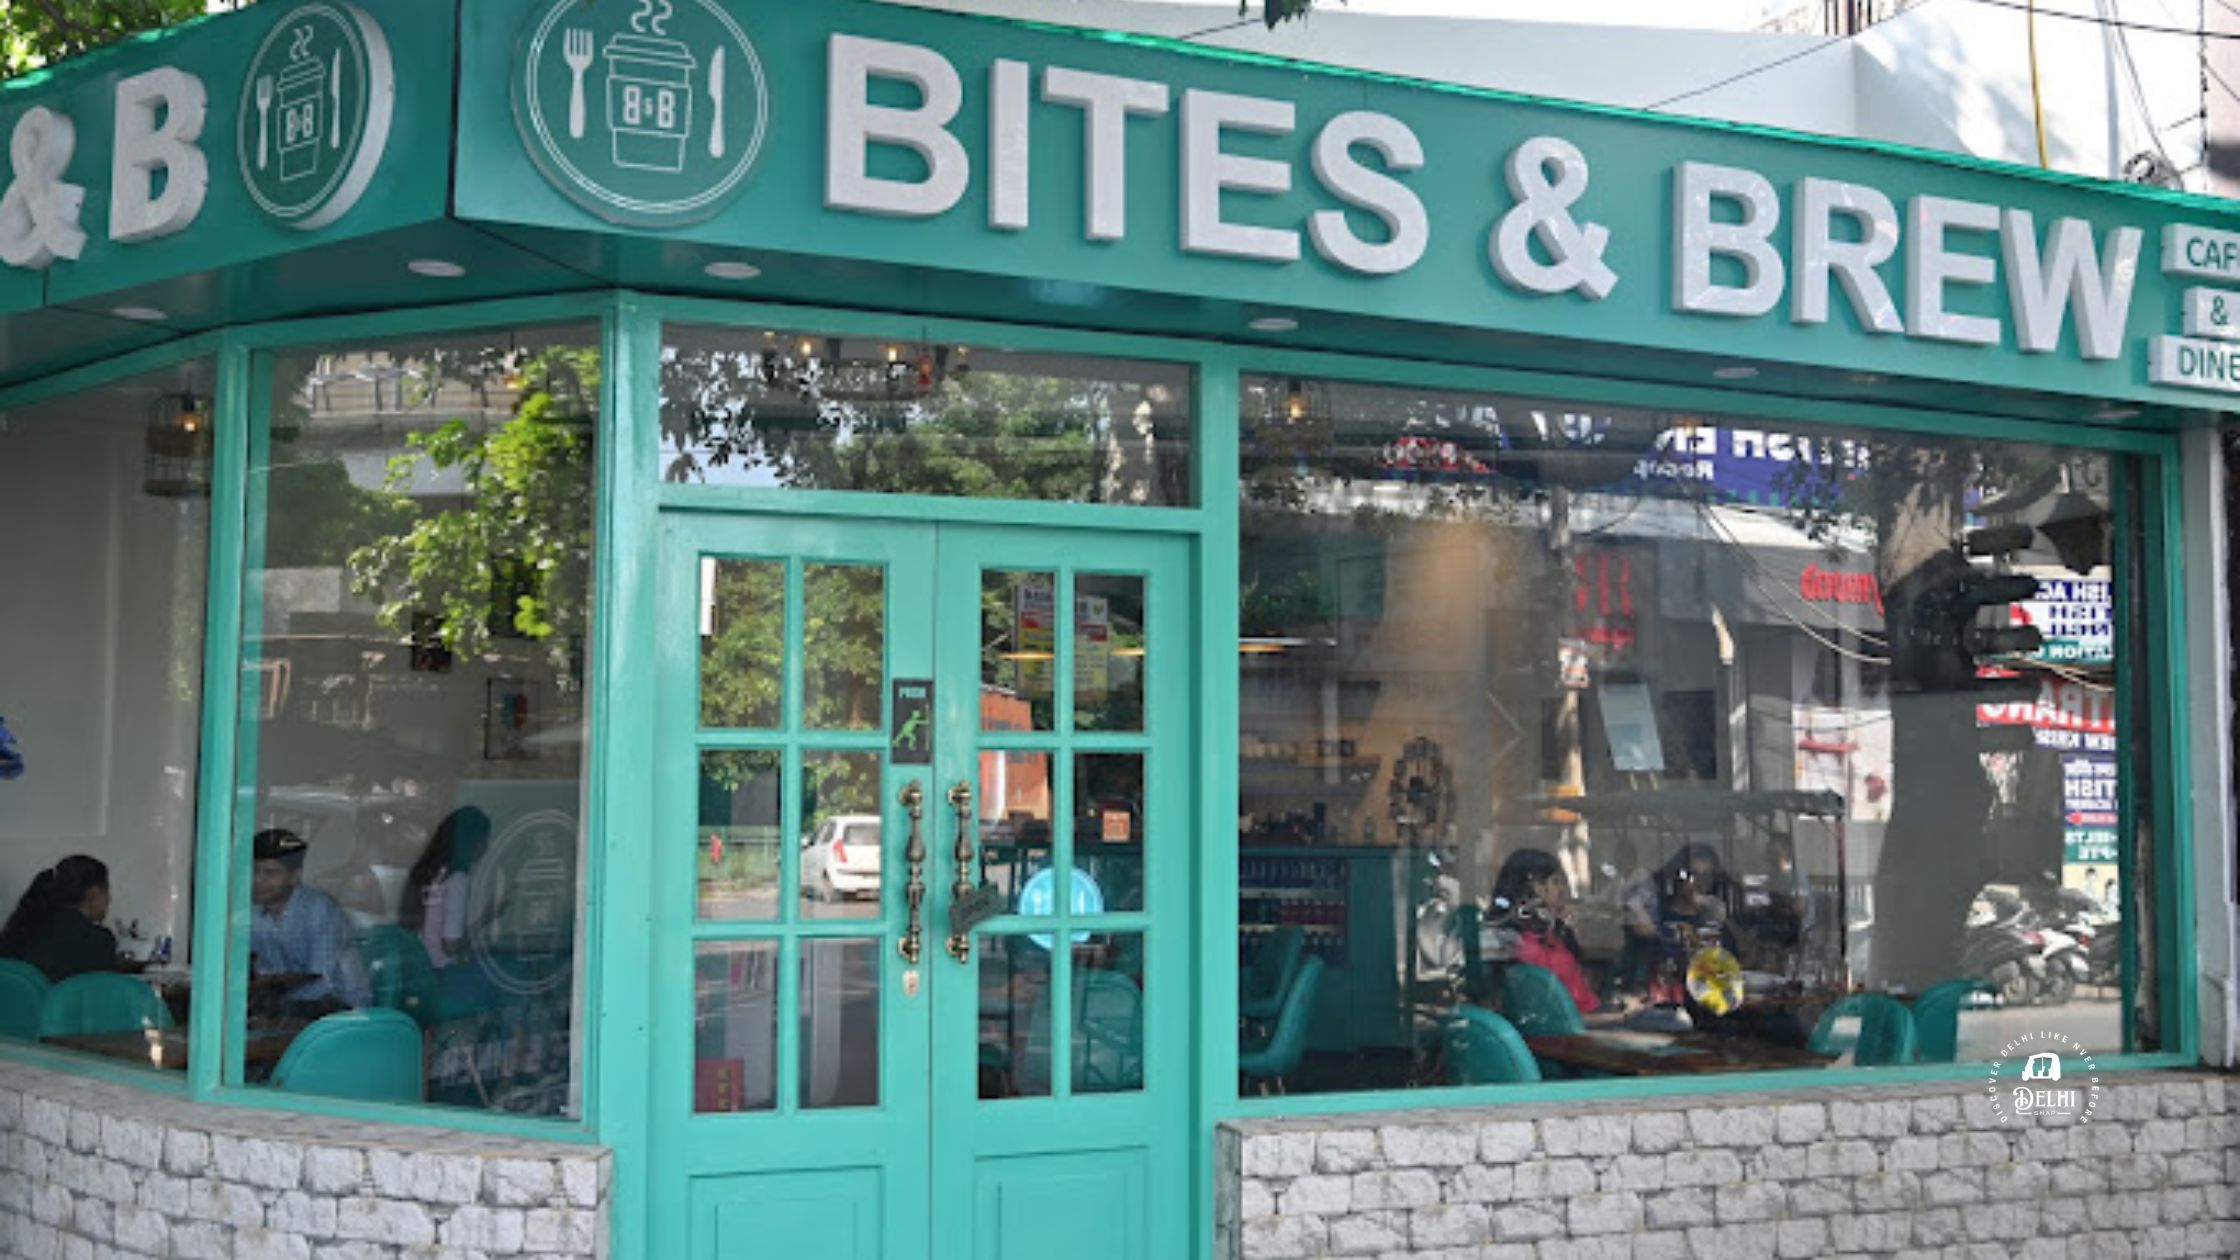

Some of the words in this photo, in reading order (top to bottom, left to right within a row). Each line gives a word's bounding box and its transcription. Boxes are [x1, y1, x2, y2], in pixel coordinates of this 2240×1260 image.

[0, 105, 87, 269] &
[109, 65, 209, 243] B
[824, 32, 1430, 275] BITES
[1488, 135, 1619, 300] &
[1671, 160, 2144, 360] BREW
[2186, 236, 2240, 270] CAF
[2210, 295, 2230, 326] &
[2179, 345, 2240, 382] DINE
